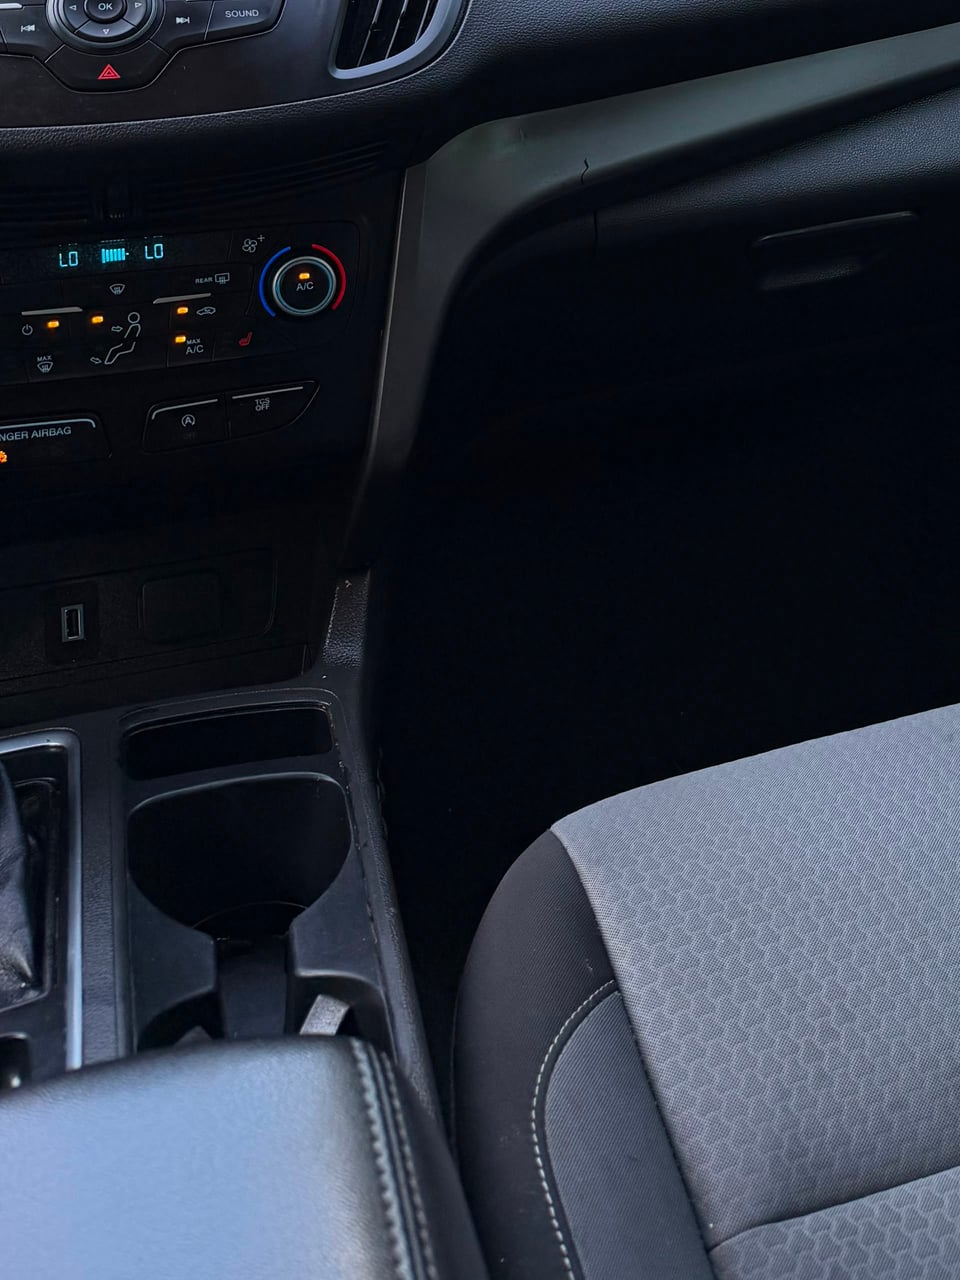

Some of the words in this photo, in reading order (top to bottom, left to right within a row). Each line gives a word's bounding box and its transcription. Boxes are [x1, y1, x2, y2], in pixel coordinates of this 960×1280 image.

[98, 2, 113, 11] OK
[225, 9, 259, 18] SOUND
[144, 243, 163, 259] LO
[59, 251, 78, 267] LO
[195, 276, 213, 284] REAR
[296, 281, 314, 291] A/C
[186, 344, 204, 355] A/C
[31, 426, 72, 438] AIRBAG
